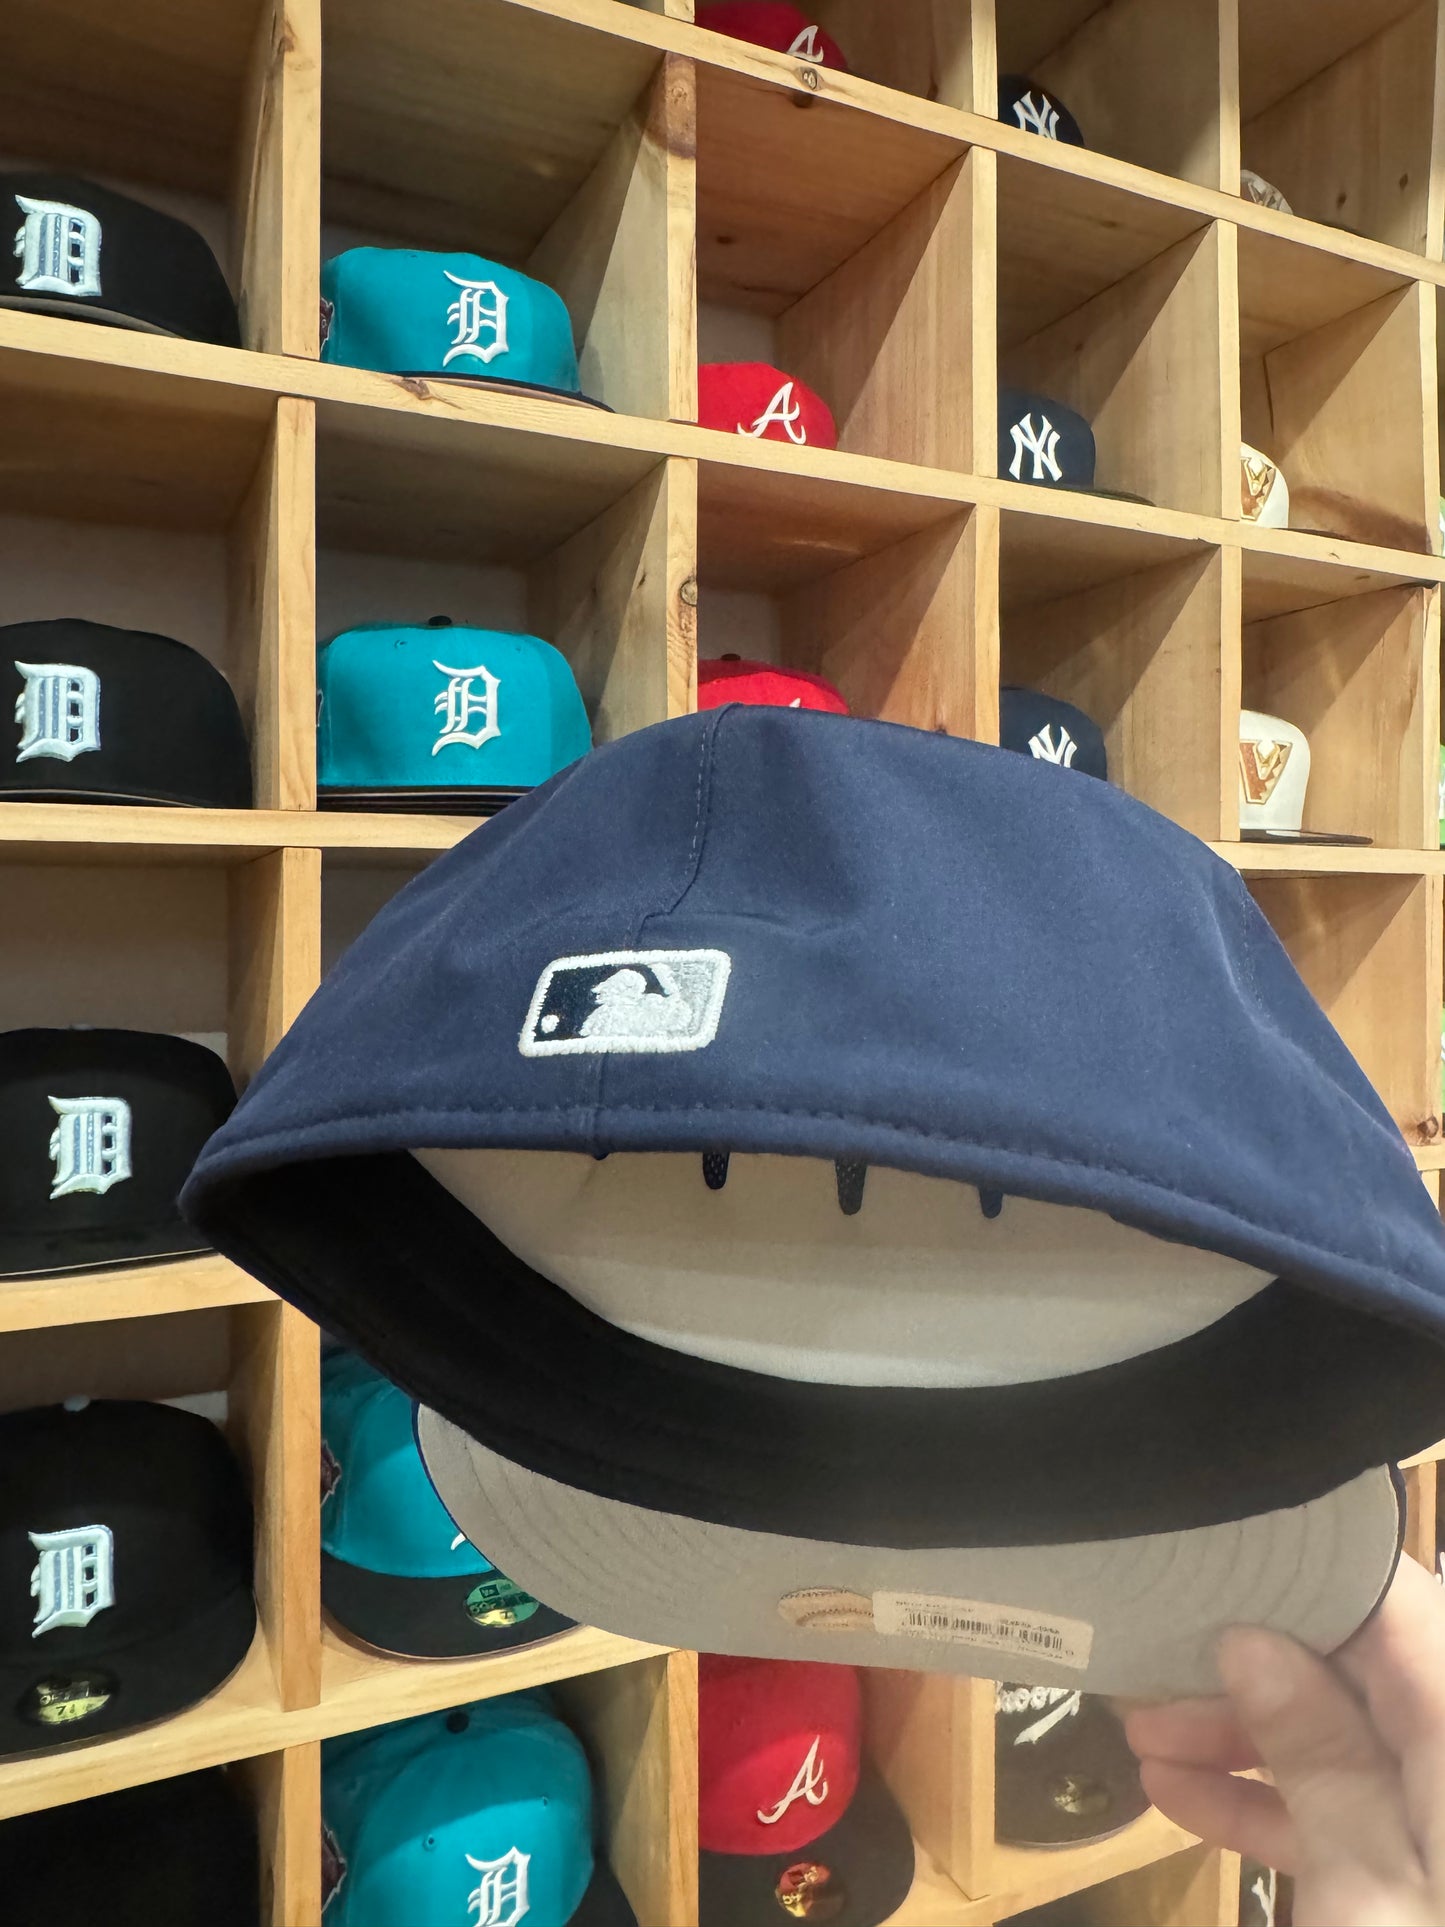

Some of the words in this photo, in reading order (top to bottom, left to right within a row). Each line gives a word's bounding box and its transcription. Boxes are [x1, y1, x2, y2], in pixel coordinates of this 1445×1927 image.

[1012, 90, 1060, 141] NY
[12, 194, 102, 297] D
[442, 270, 509, 366] D
[737, 381, 806, 445] A
[1008, 412, 1063, 482] NY
[14, 660, 101, 764] D
[433, 660, 501, 757] D
[48, 1095, 133, 1199] D
[29, 1524, 116, 1639] D
[756, 1735, 828, 1825] A
[464, 1846, 531, 1927] D
